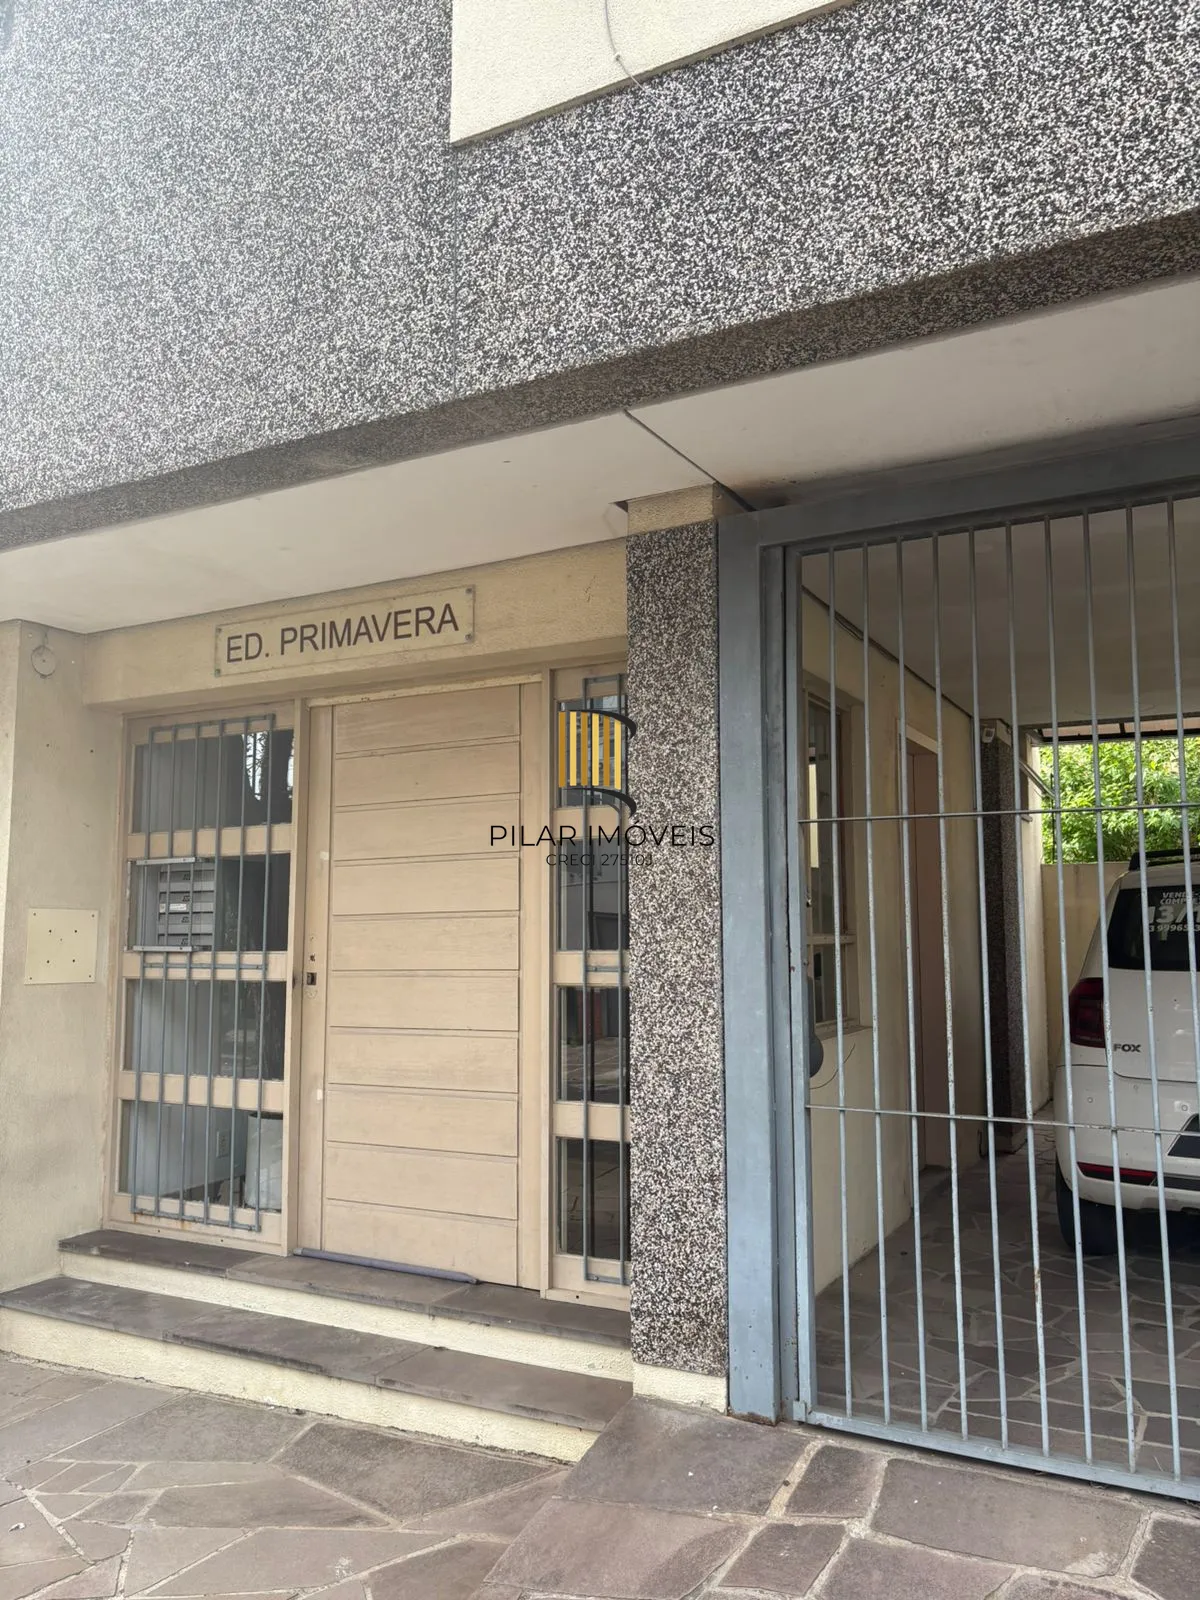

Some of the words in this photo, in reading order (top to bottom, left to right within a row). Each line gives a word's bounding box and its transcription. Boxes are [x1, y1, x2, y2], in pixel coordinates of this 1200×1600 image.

[226, 632, 270, 663] ED.
[280, 603, 460, 655] PRIMAVERA
[1113, 1043, 1141, 1053] FOX
